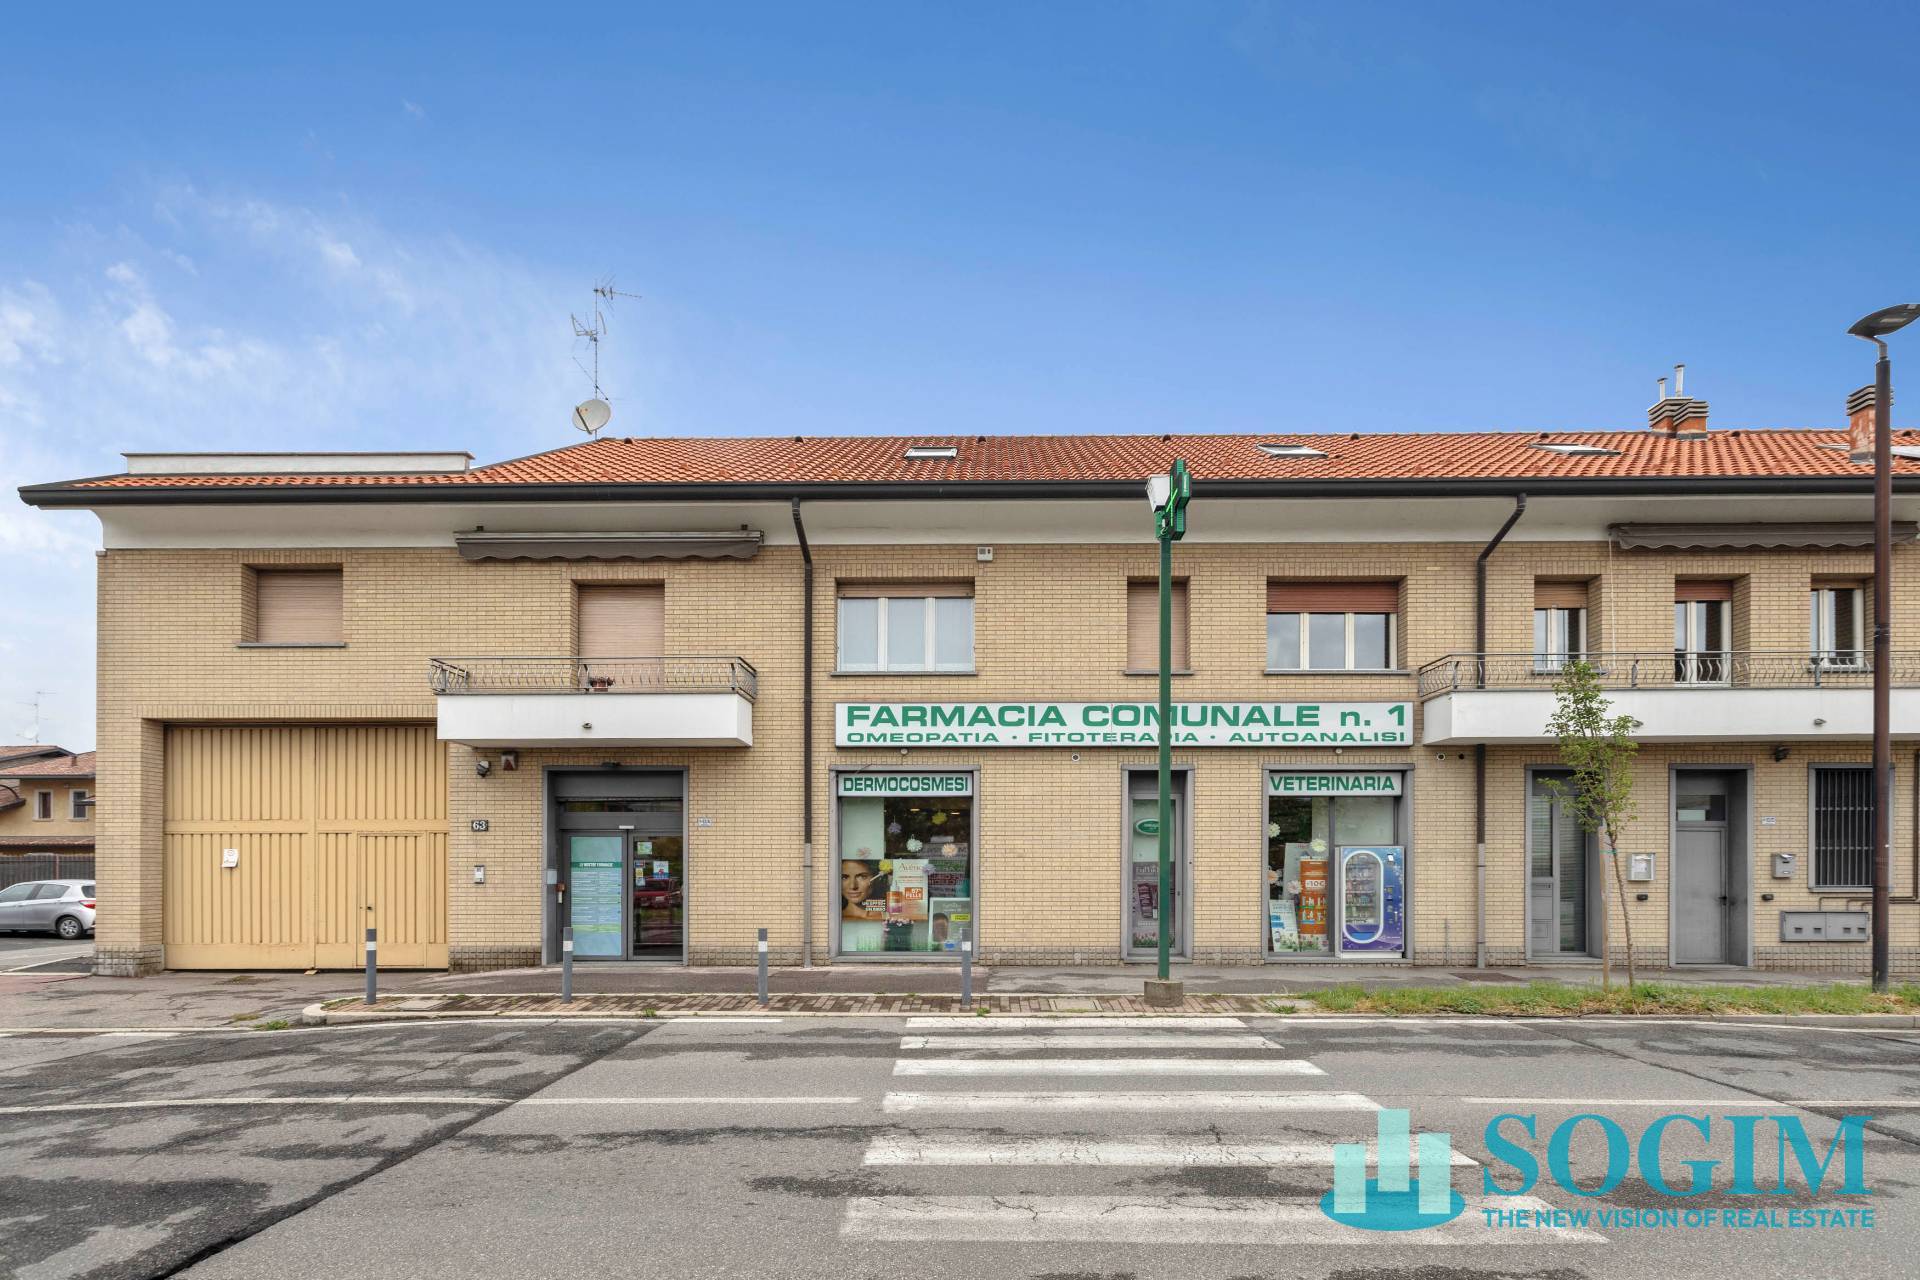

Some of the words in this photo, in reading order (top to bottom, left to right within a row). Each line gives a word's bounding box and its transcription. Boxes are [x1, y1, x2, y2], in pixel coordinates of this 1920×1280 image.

[847, 705, 1067, 727] FARMACIA
[1082, 705, 1320, 727] COMUNALE
[1340, 710, 1371, 727] n.
[1388, 705, 1405, 726] 1
[847, 732, 999, 743] OMEOPATIA
[1028, 732, 1199, 743] FITOTERAIA
[1228, 732, 1405, 742] AUTOANALISI
[843, 776, 968, 792] DERMOCOSMESI
[1269, 776, 1395, 791] VETERINARIA
[473, 820, 487, 830] 63
